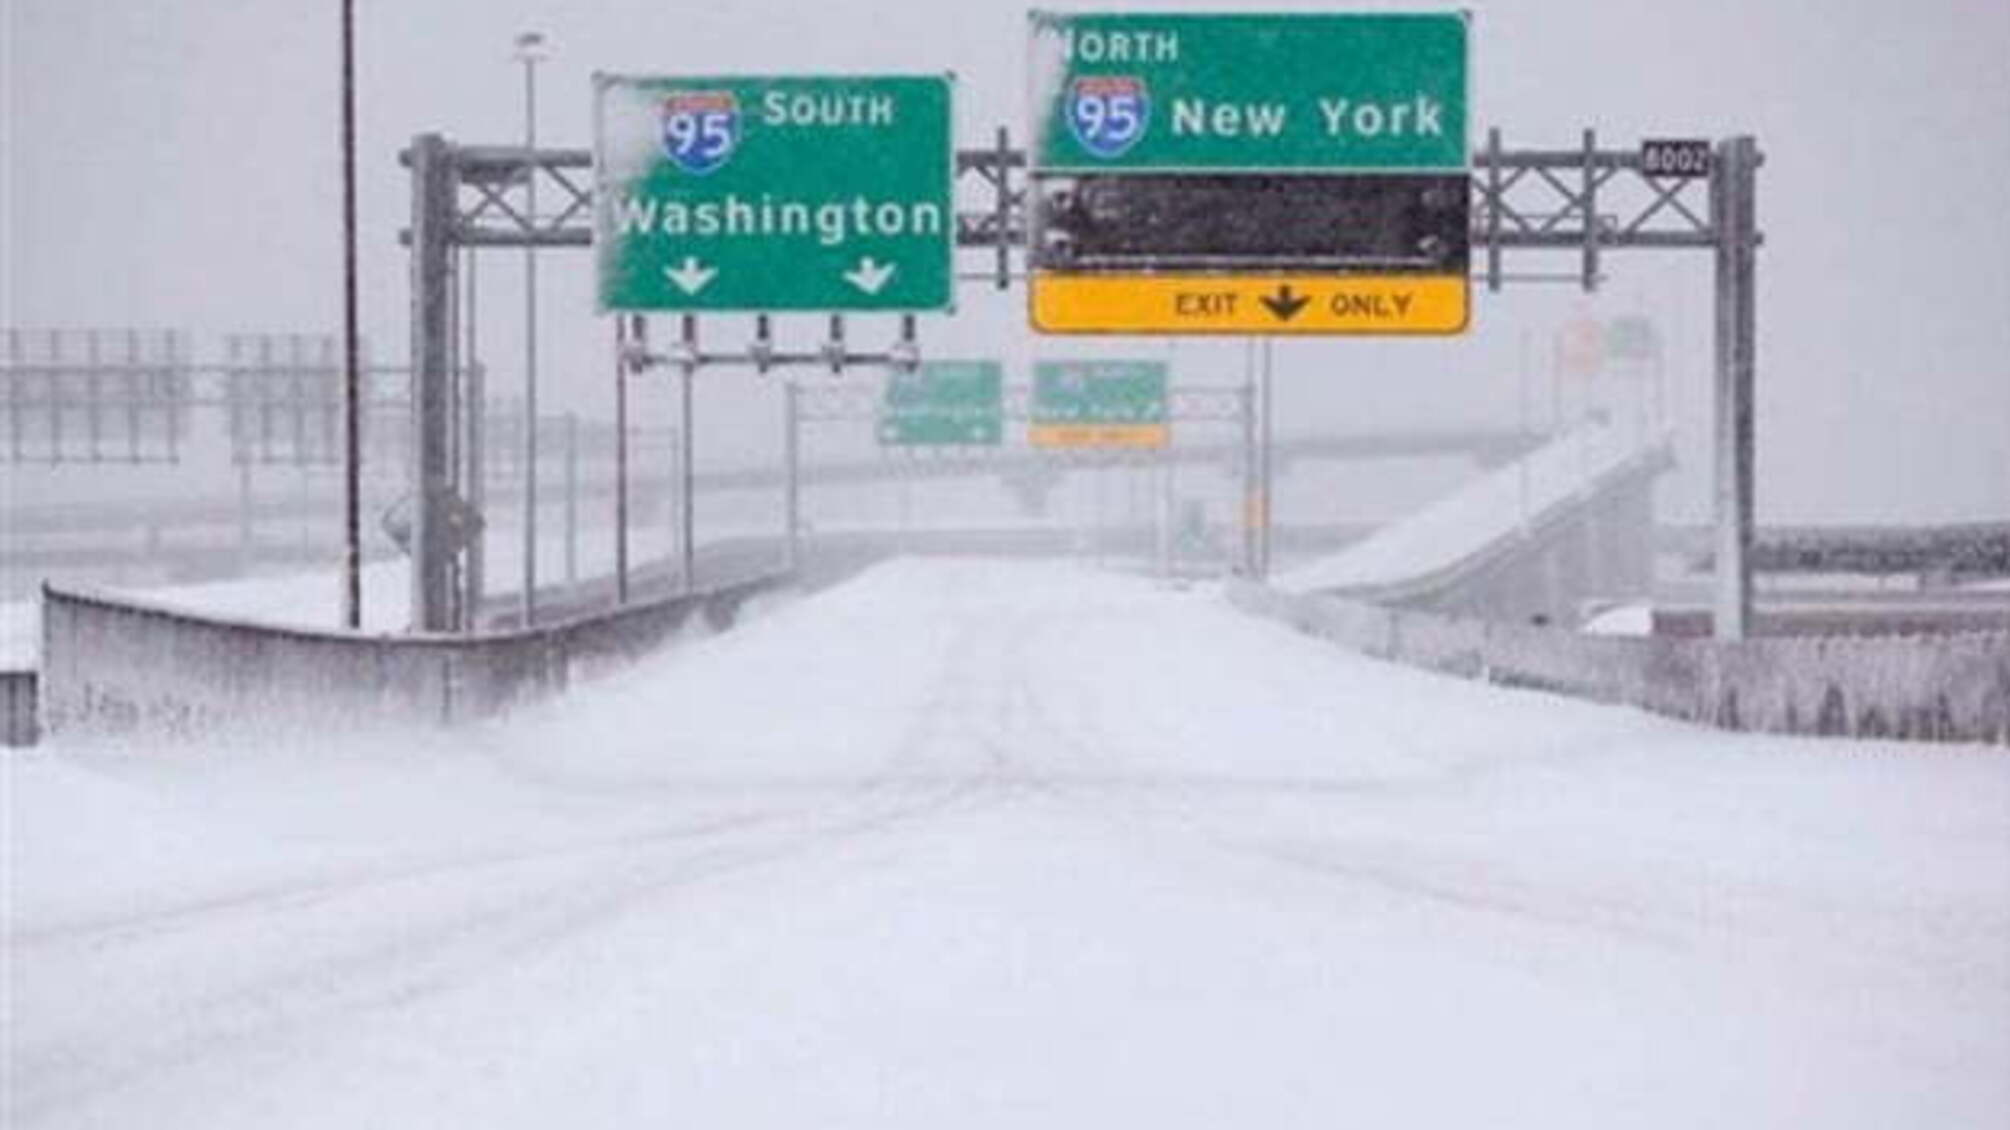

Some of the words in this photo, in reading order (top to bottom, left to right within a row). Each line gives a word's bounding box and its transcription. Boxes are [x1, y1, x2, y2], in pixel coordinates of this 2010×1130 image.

[763, 90, 893, 126] SOUTH
[1077, 95, 1137, 141] 95
[1171, 98, 1287, 136] New
[1319, 95, 1444, 136] York
[669, 112, 730, 157] 95
[614, 192, 942, 246] Washington
[1175, 292, 1238, 317] EXIT
[1331, 292, 1412, 317] ONLY
